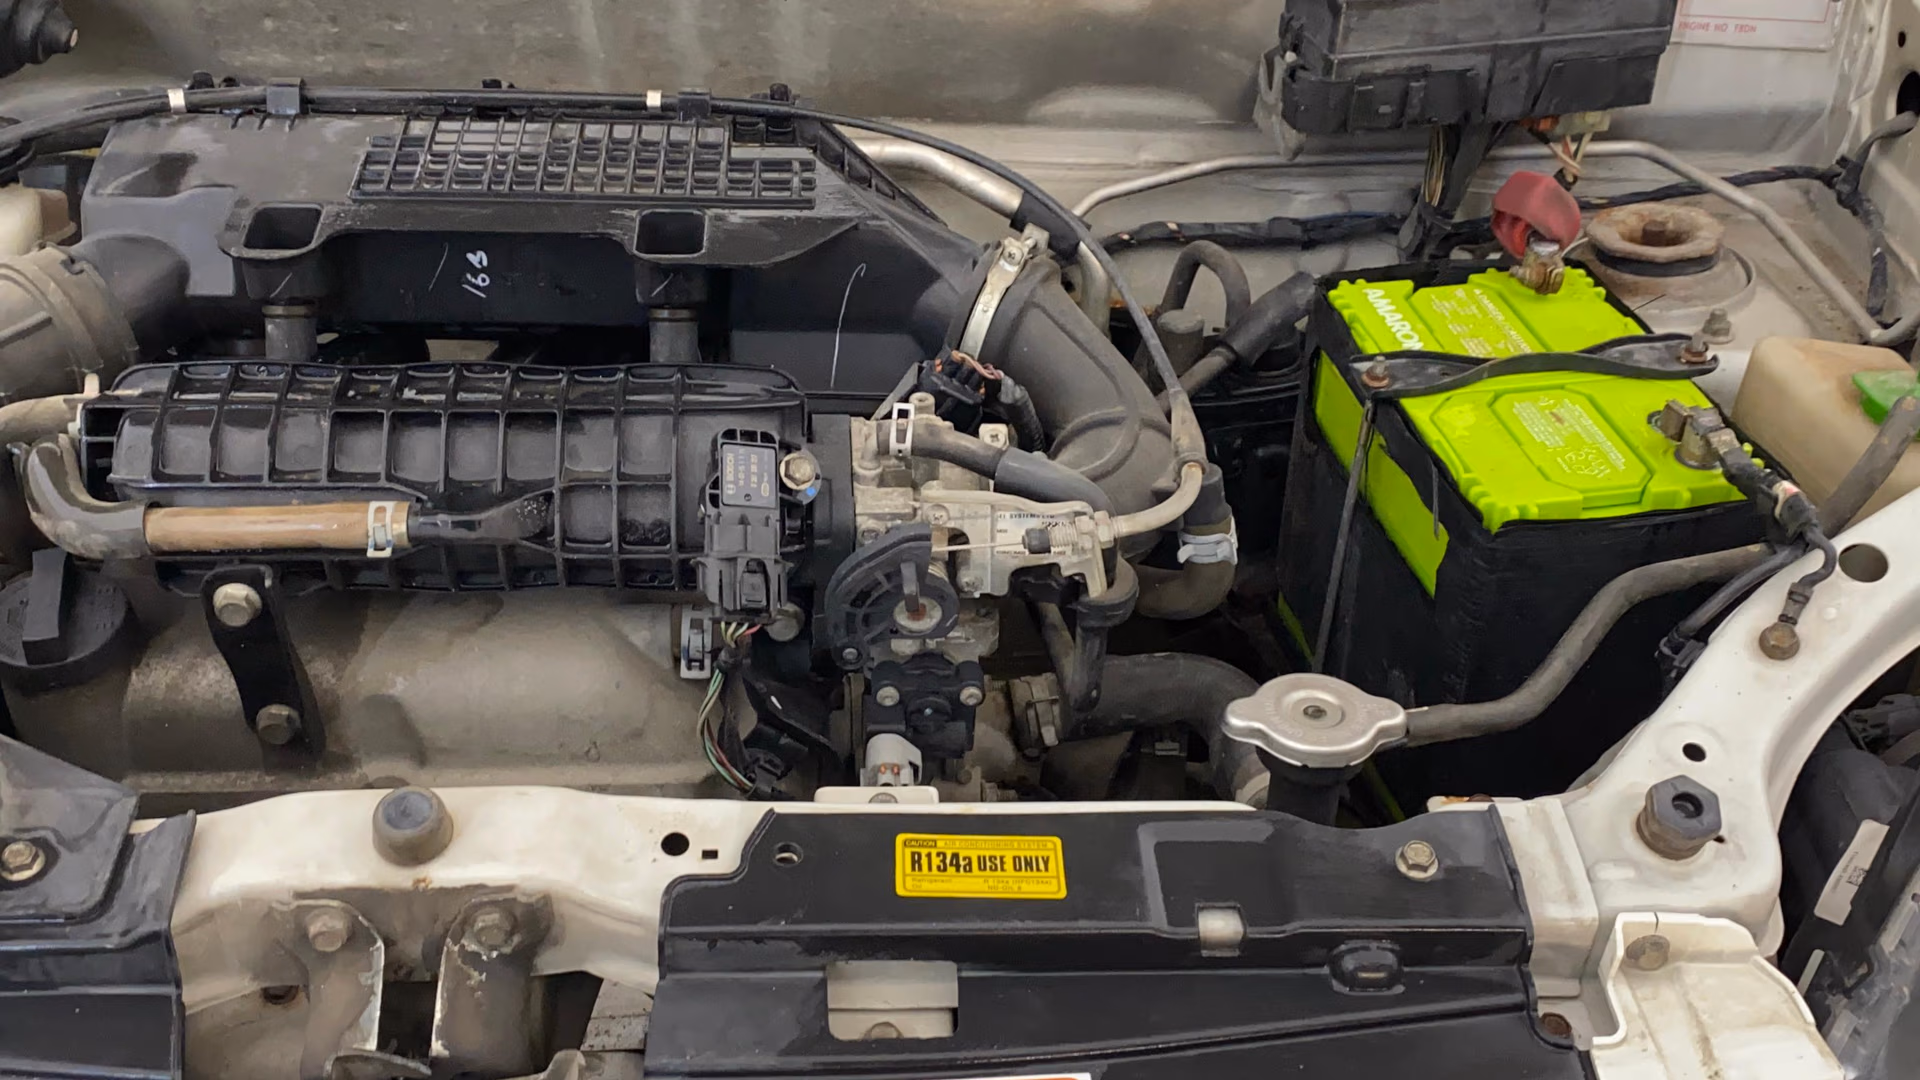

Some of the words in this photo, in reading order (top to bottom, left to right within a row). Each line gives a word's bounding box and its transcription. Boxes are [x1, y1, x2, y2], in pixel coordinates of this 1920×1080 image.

[905, 840, 936, 848] CAUTION
[944, 841, 958, 849] AIR
[959, 841, 1015, 850] CONDITIONING
[1017, 842, 1050, 850] SYSTEM
[911, 850, 974, 874] R134a
[977, 854, 1008, 873] USE
[1012, 854, 1051, 873] ONLY
